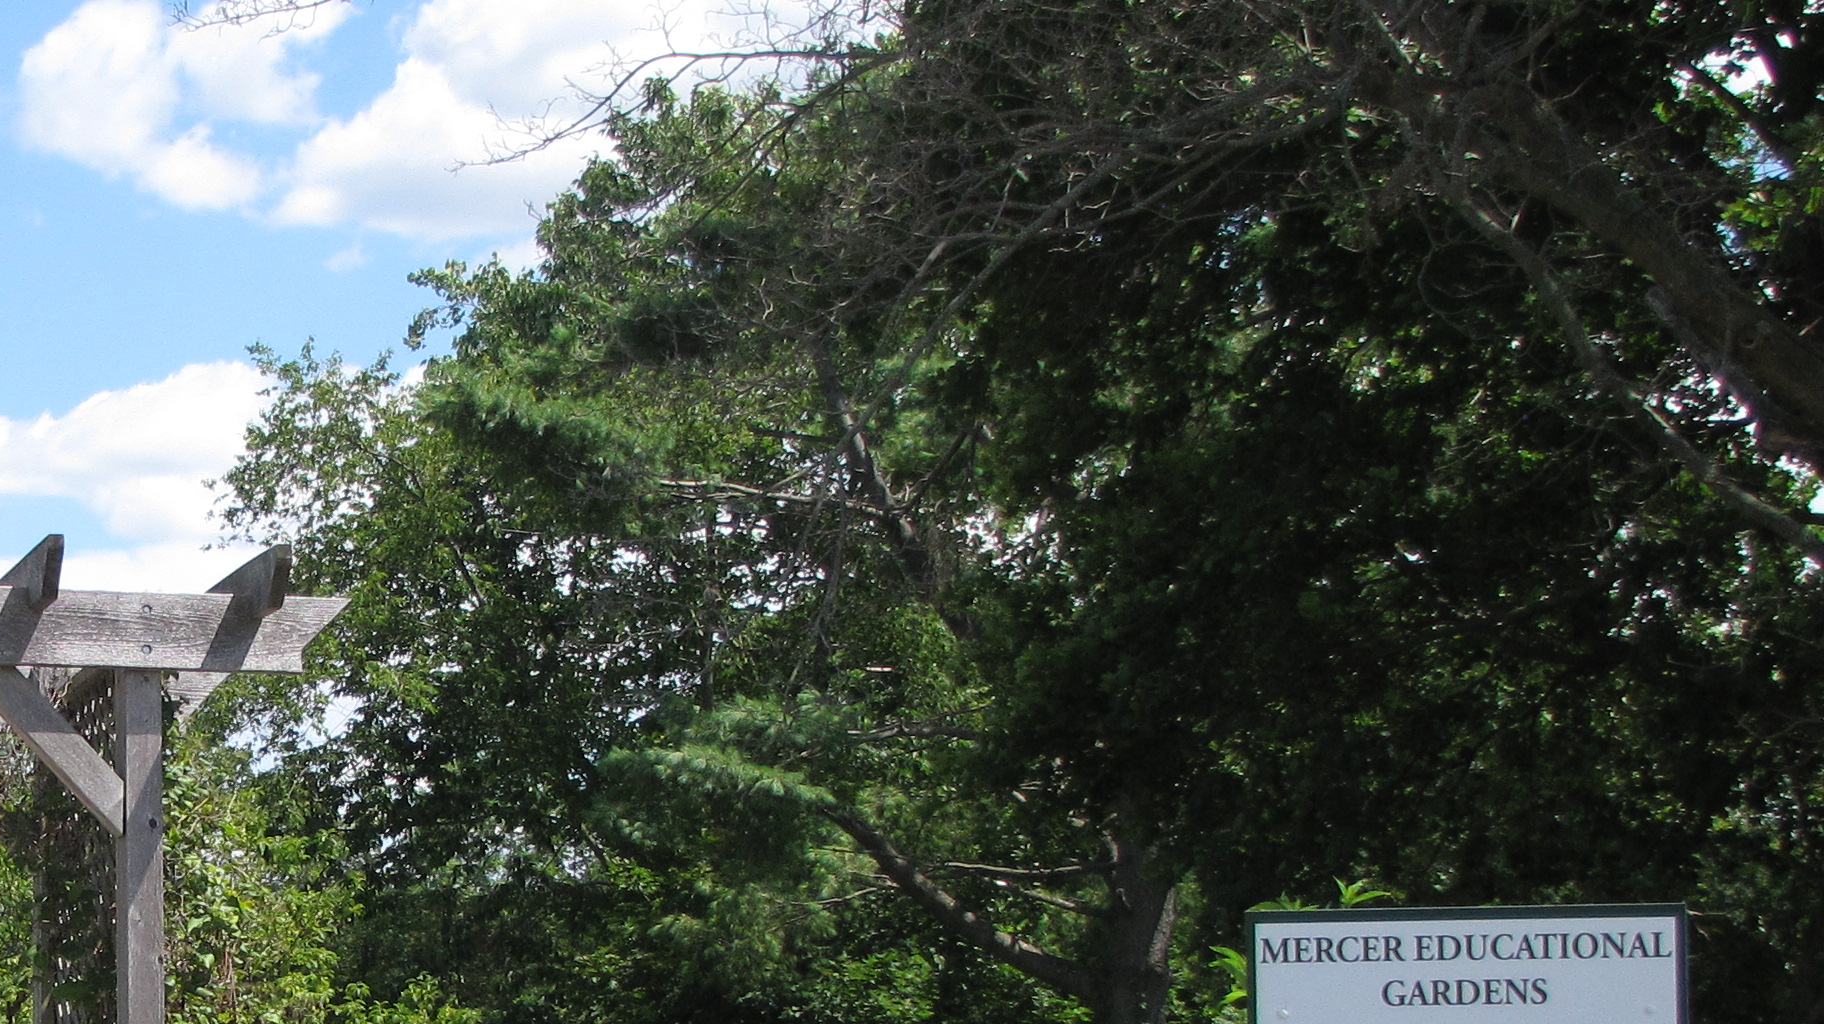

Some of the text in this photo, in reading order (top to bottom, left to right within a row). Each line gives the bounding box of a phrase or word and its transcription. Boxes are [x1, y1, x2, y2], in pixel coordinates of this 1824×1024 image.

[1260, 931, 1672, 964] MERCER EDUCATIONAL
[1380, 977, 1548, 1007] GARDENS
